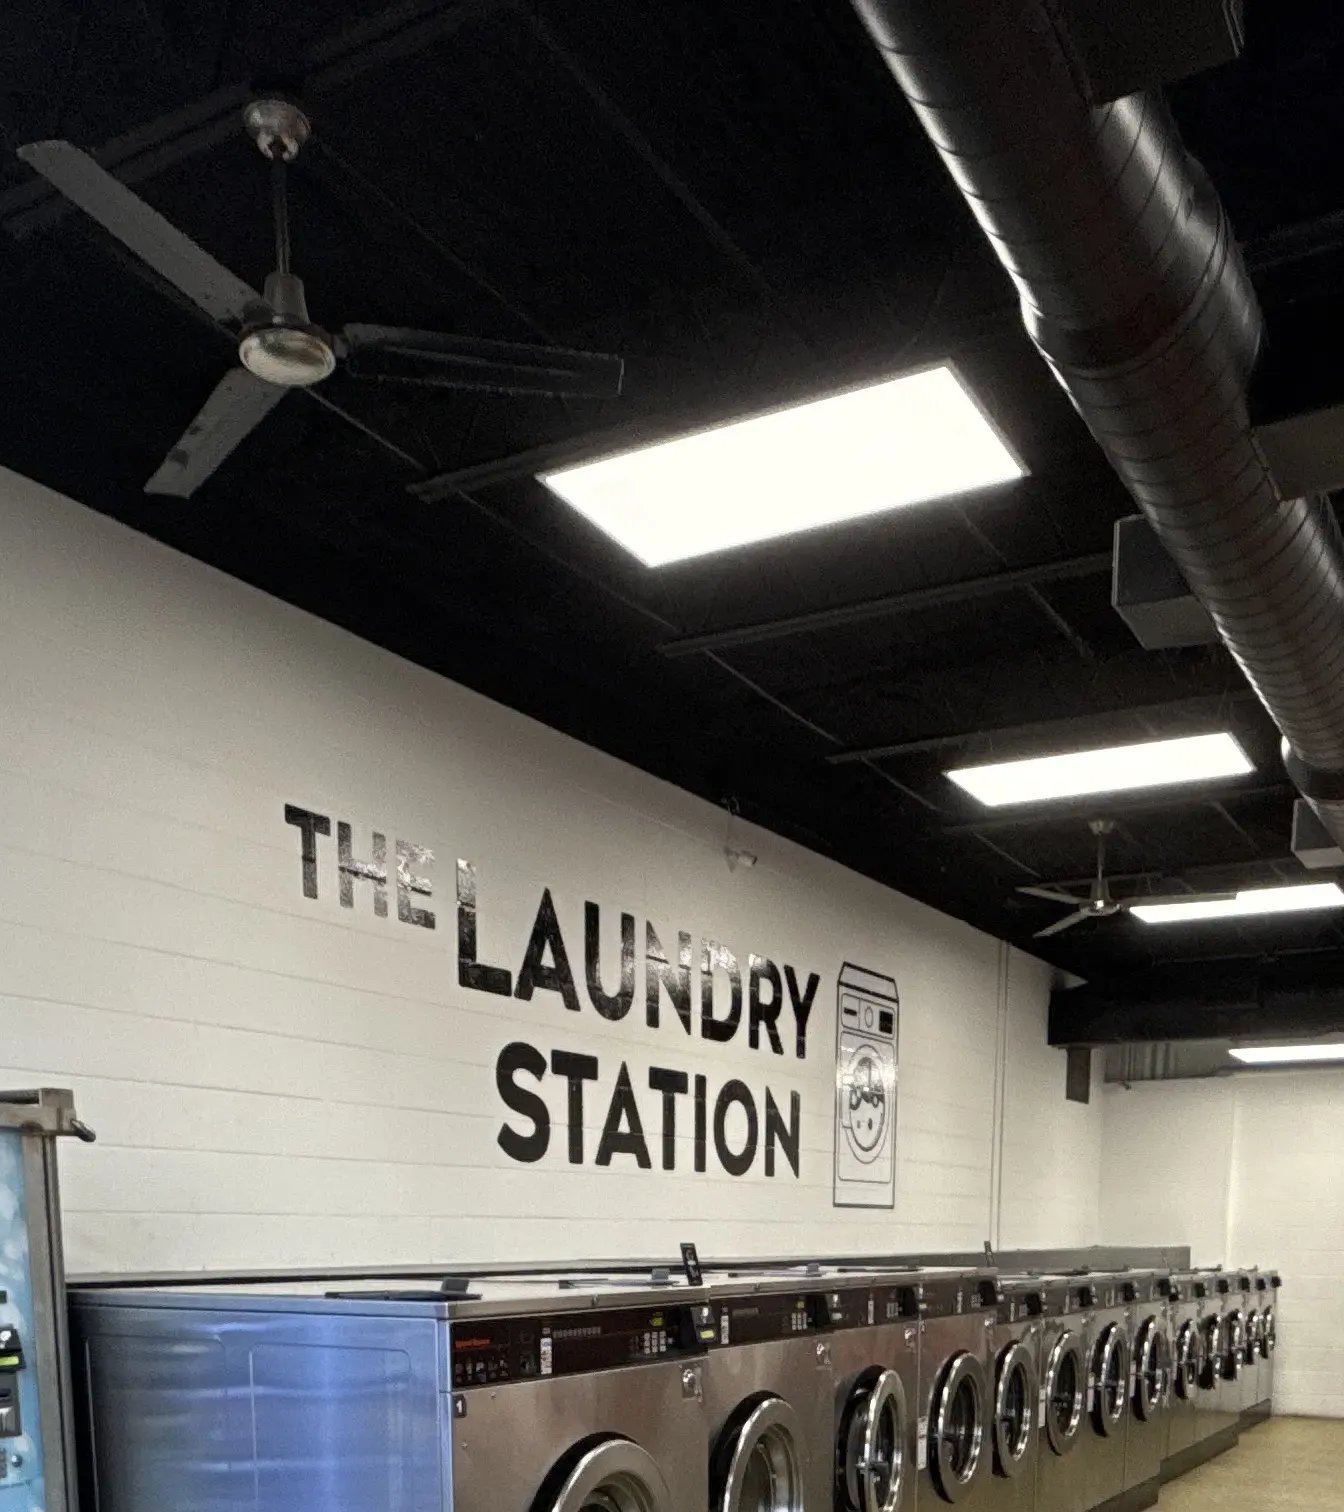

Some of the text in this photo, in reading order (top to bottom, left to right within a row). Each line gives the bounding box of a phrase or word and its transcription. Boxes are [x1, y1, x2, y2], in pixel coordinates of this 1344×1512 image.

[284, 804, 821, 1060] THE LAUNDRY
[495, 1041, 801, 1180] STATION
